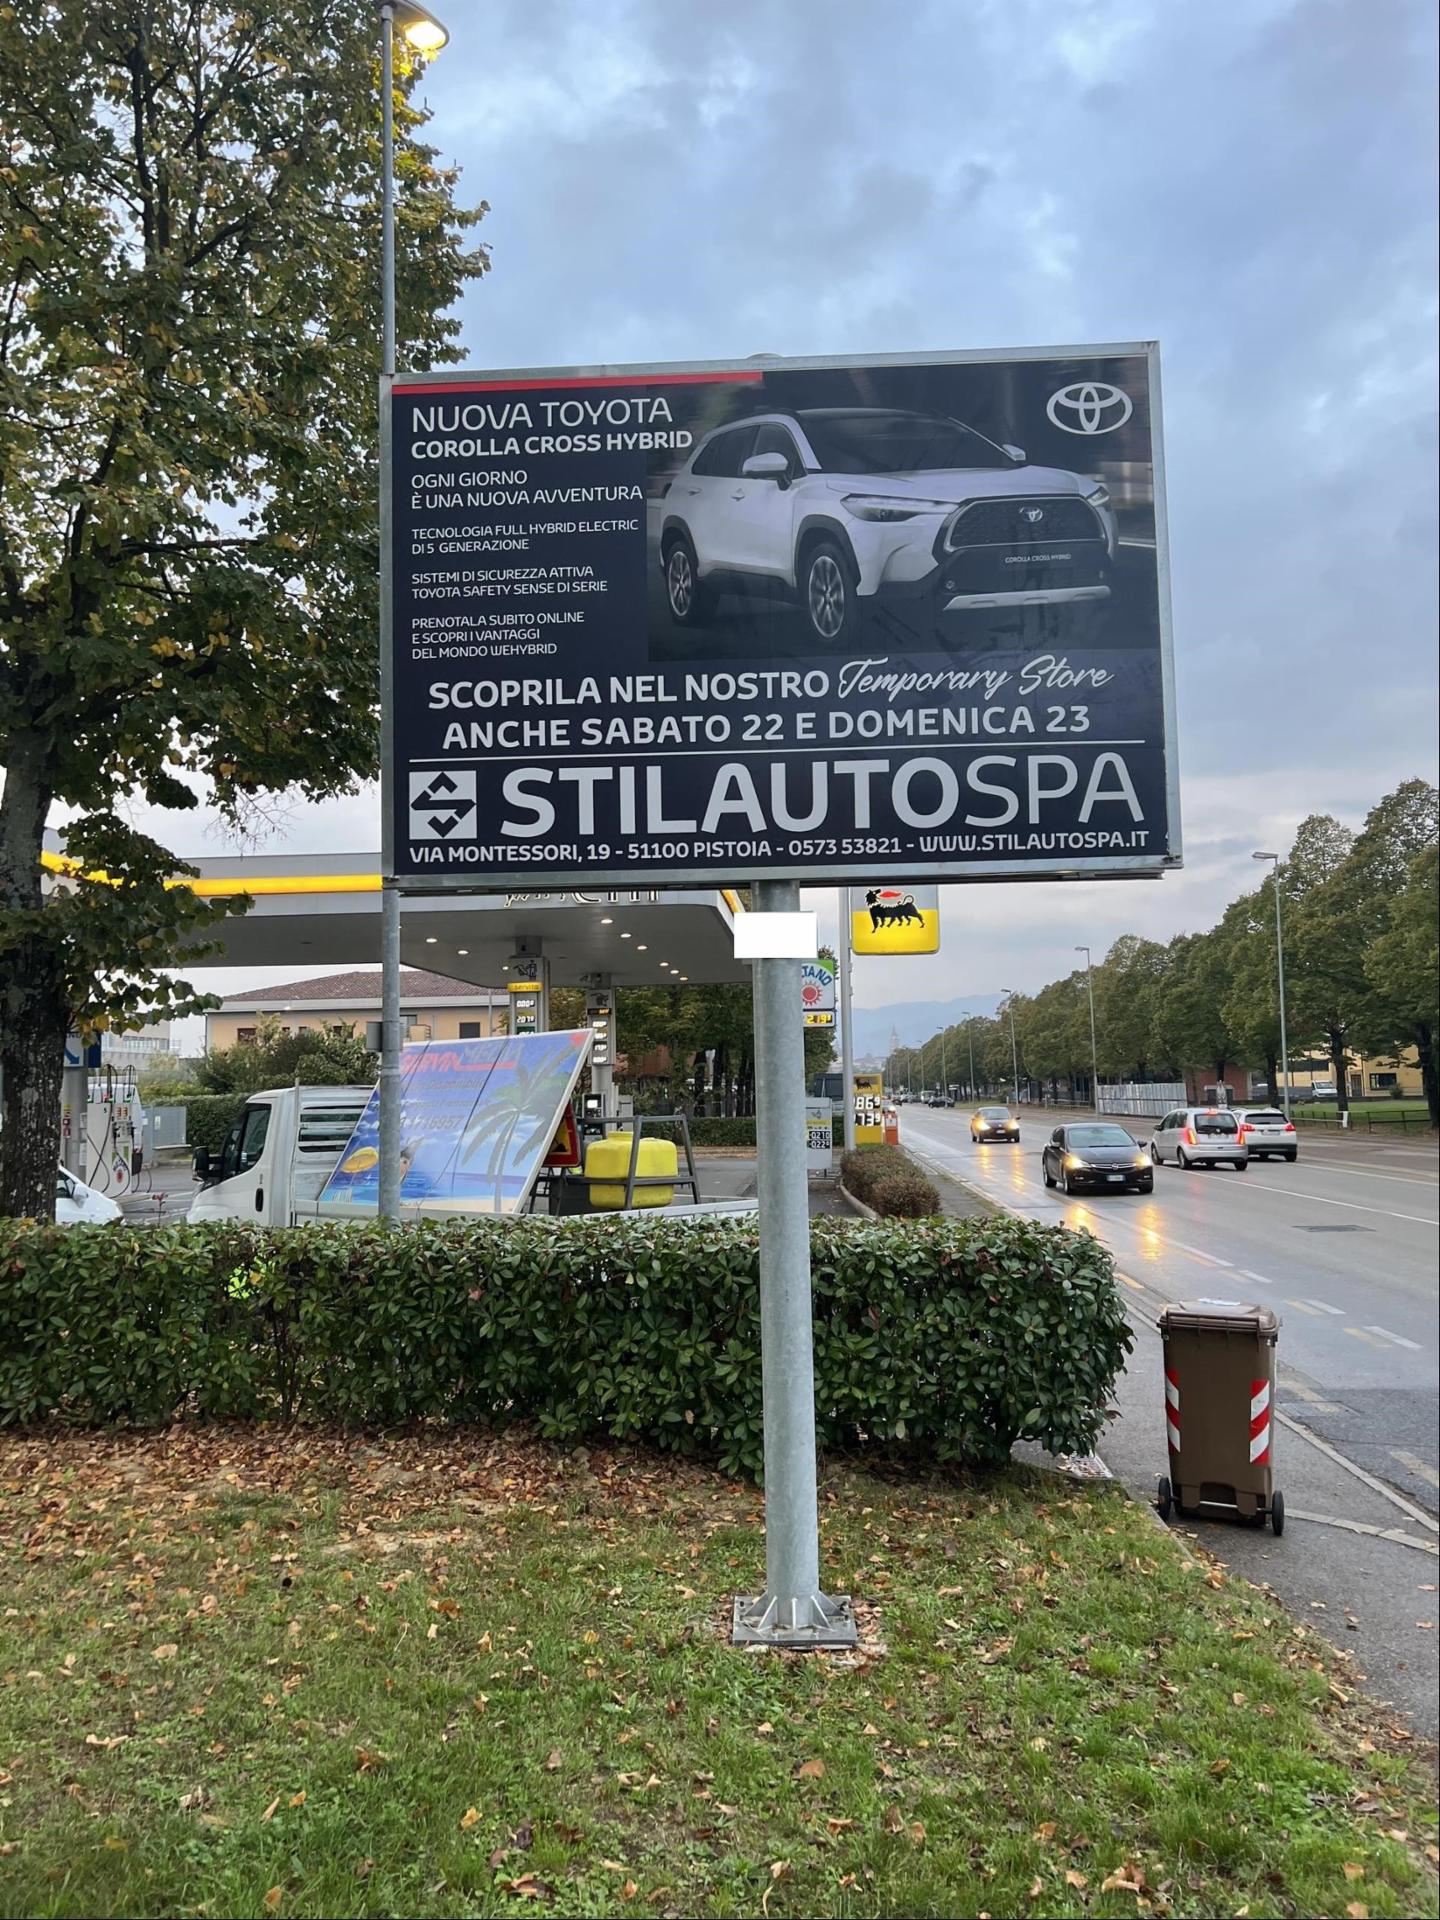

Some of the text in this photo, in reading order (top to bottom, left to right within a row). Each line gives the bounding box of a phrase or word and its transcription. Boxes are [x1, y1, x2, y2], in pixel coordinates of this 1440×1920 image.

[413, 397, 673, 432] NUOVA TOYOTA
[412, 431, 692, 459] COROLLA CROSS HYBRID
[412, 470, 527, 488] OGNI GIORNO
[412, 486, 643, 509] È UNA NUOVA AVVENTURA
[411, 519, 638, 539] TECNOLOGIA FULL HYBRID ELECTRIC
[412, 539, 529, 555] DI 5 GENERAZIONE
[412, 566, 594, 584] SISTEMI DI SICUREZZA ATTIVA
[412, 581, 608, 599] TOYOTA SAFETY SENSE DI SERIE
[412, 612, 584, 629] PRENOTALA SUBITO ONLINE
[412, 633, 420, 644] E
[422, 631, 467, 644] SCOPRI
[475, 628, 540, 641] VANTAGGI
[412, 643, 557, 659] DEL MONDO WEHYBRID
[429, 655, 1114, 709] SCOPRILA NEL NOSTRO Temporary Store
[443, 706, 1090, 749] ANCHE SABATO 22 E DOMENICA 23
[500, 751, 1144, 838] STILAUTOSPA
[410, 847, 444, 863] VIA
[449, 844, 582, 862] MONTESSORI,
[587, 844, 610, 859] 19
[628, 842, 689, 859] 51100
[694, 841, 772, 857] PISTOIA
[789, 839, 837, 855] 0573
[841, 837, 902, 854] 53821
[919, 831, 1149, 852] WWW.STILAUTOSPA.IT
[802, 966, 832, 986] TANO
